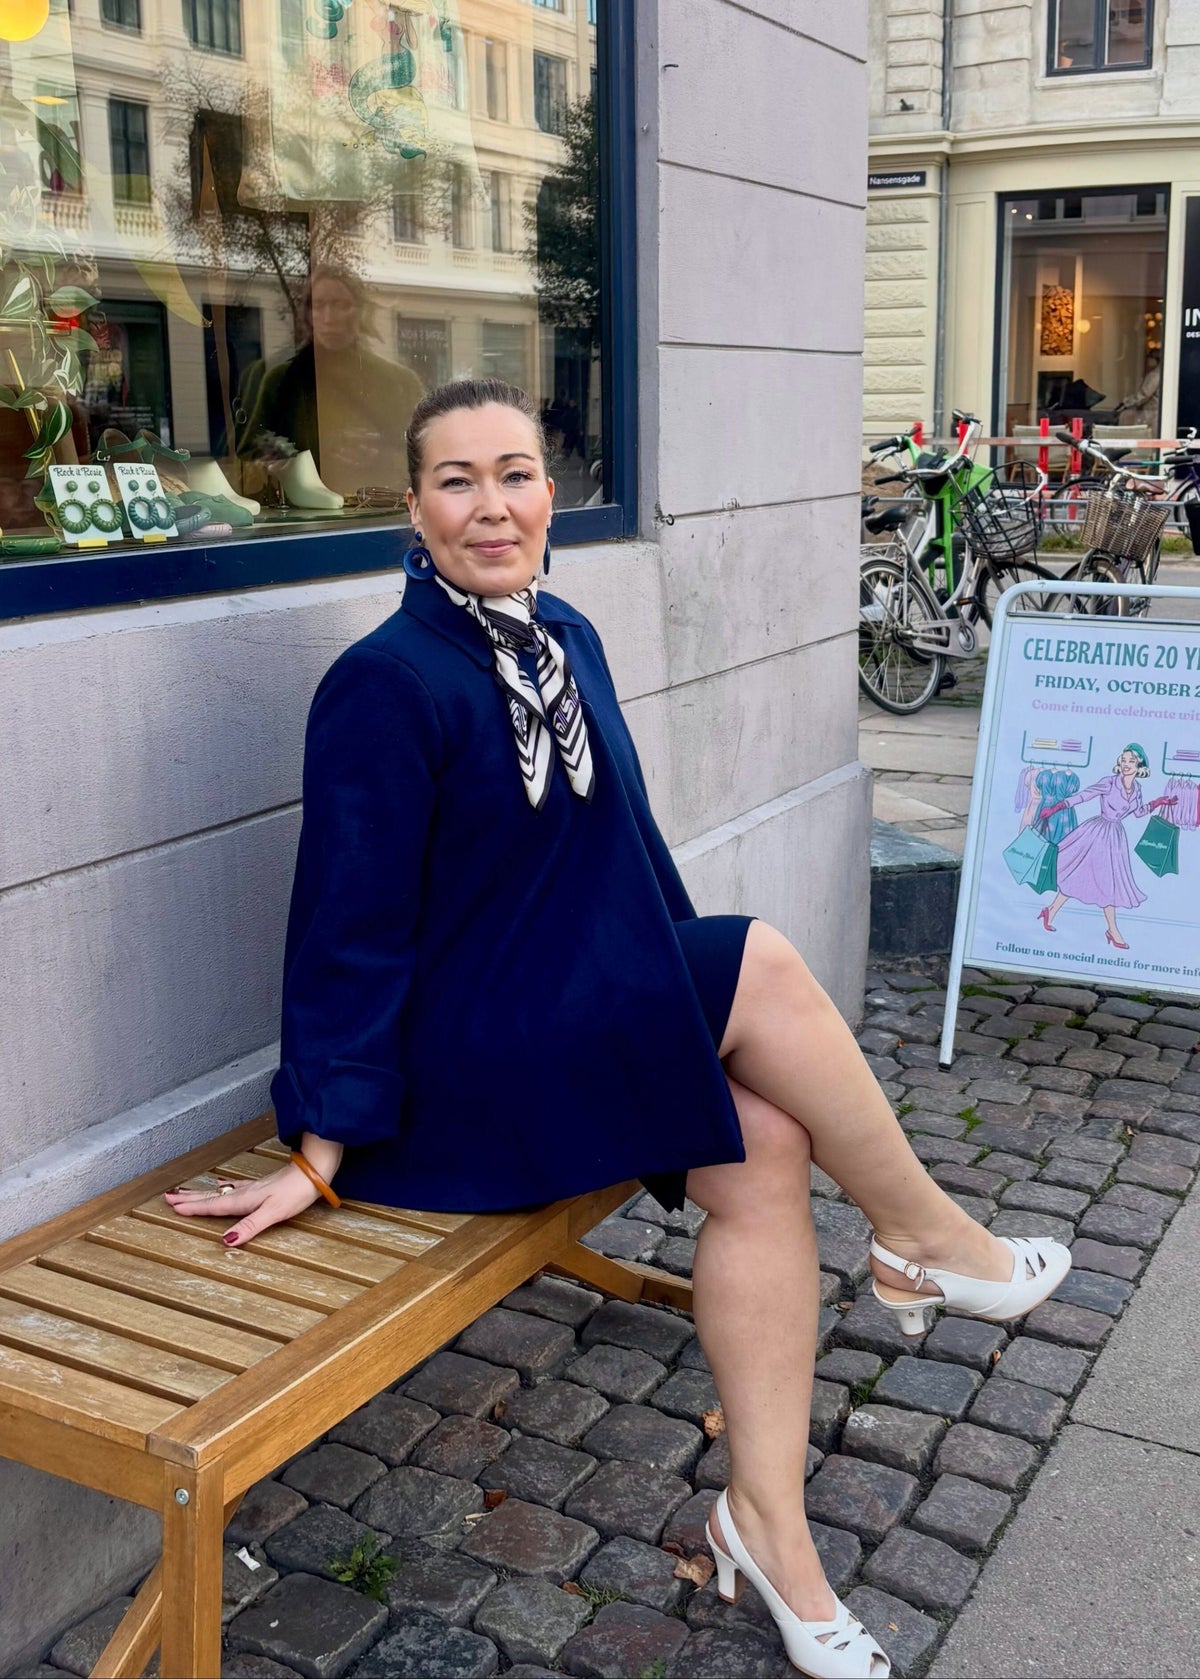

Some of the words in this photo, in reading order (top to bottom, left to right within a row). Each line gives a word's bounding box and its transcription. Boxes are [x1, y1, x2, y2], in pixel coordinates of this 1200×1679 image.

[869, 174, 921, 185] Nansensgade
[53, 467, 75, 477] Rock
[1023, 638, 1149, 668] CELEBRATING
[1154, 645, 1178, 669] 20
[1034, 674, 1100, 693] FRIDAY,
[1107, 679, 1191, 698] OCTOBER
[1032, 699, 1068, 713] Come
[1071, 701, 1083, 714] in
[1086, 703, 1111, 716] and
[1114, 705, 1176, 720] celebrate
[995, 941, 1031, 955] Follow
[1033, 948, 1045, 957] us
[1047, 950, 1060, 959] on
[1063, 951, 1095, 964] social
[1097, 957, 1131, 968] media
[1133, 960, 1150, 971] for
[1151, 964, 1180, 975] more
